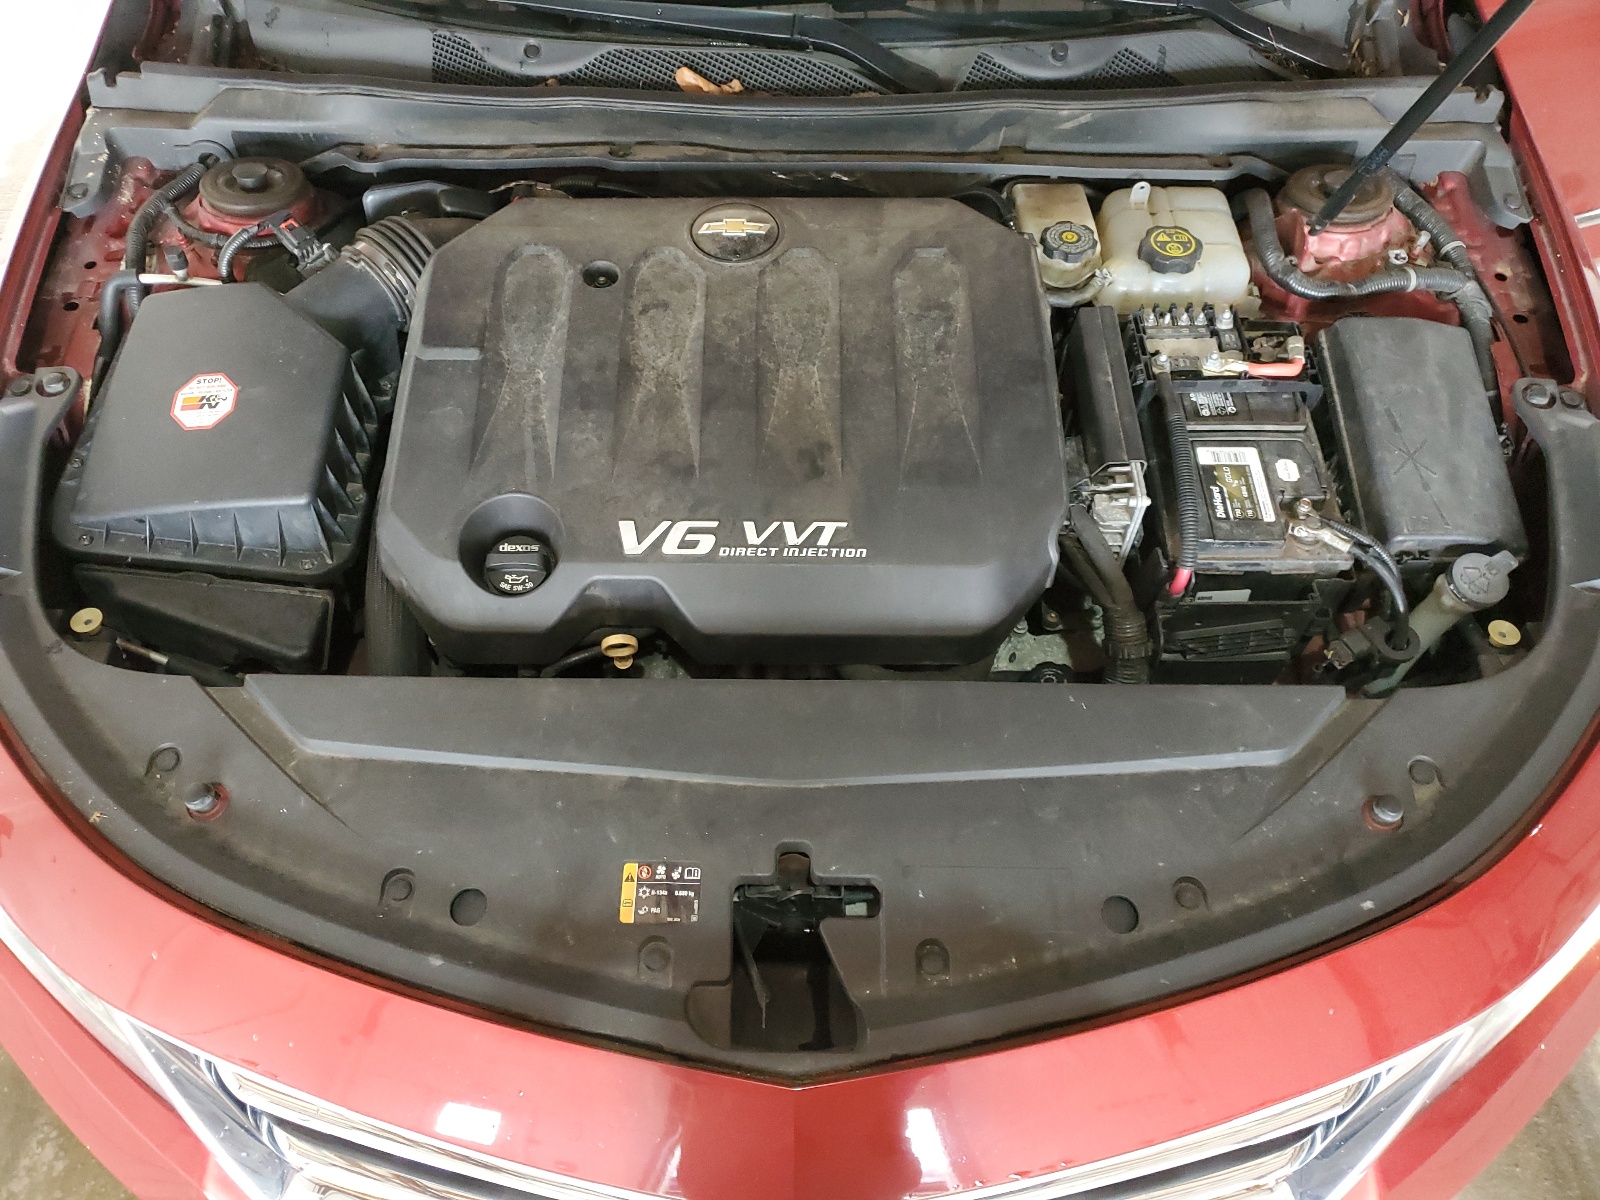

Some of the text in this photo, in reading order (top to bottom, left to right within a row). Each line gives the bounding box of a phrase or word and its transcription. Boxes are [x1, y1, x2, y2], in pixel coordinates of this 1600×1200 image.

[1222, 466, 1232, 483] GOLD
[1210, 486, 1226, 518] DieHard
[618, 520, 849, 556] V6 VVT
[499, 542, 541, 552] dexos
[718, 547, 868, 558] DIRECT INJECTION
[499, 581, 534, 591] SAE 5W-30
